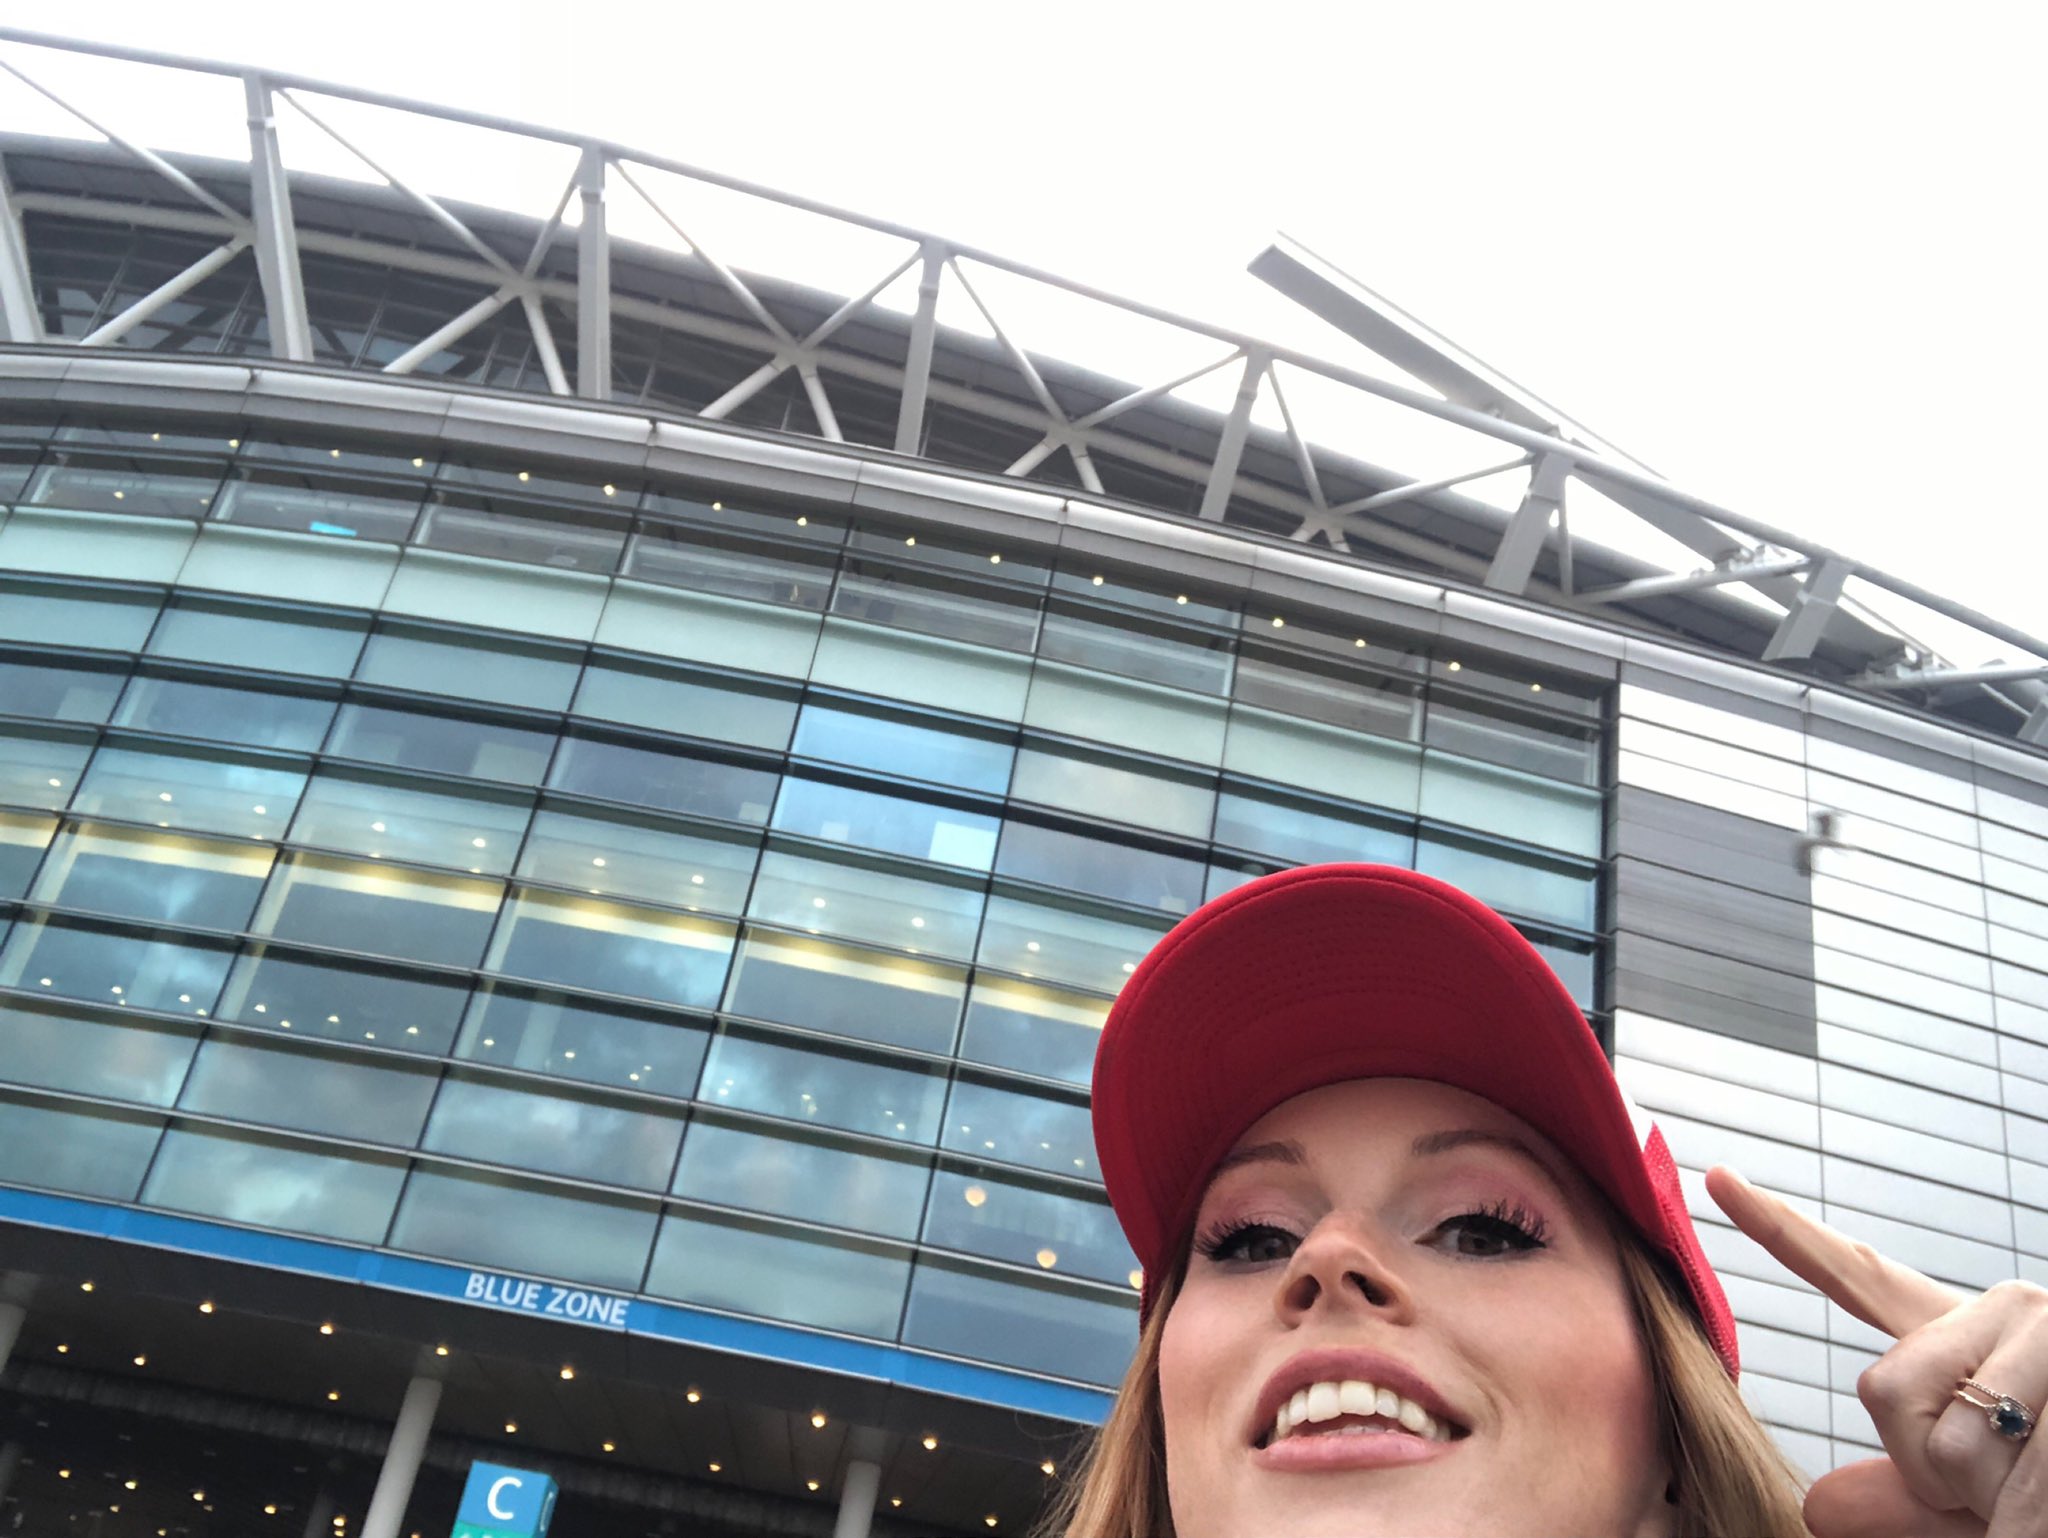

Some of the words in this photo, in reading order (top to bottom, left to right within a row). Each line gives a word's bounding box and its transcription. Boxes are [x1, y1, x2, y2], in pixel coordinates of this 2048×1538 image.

[464, 1272, 543, 1310] BLUE
[545, 1287, 630, 1326] ZONE
[487, 1476, 523, 1520] C
